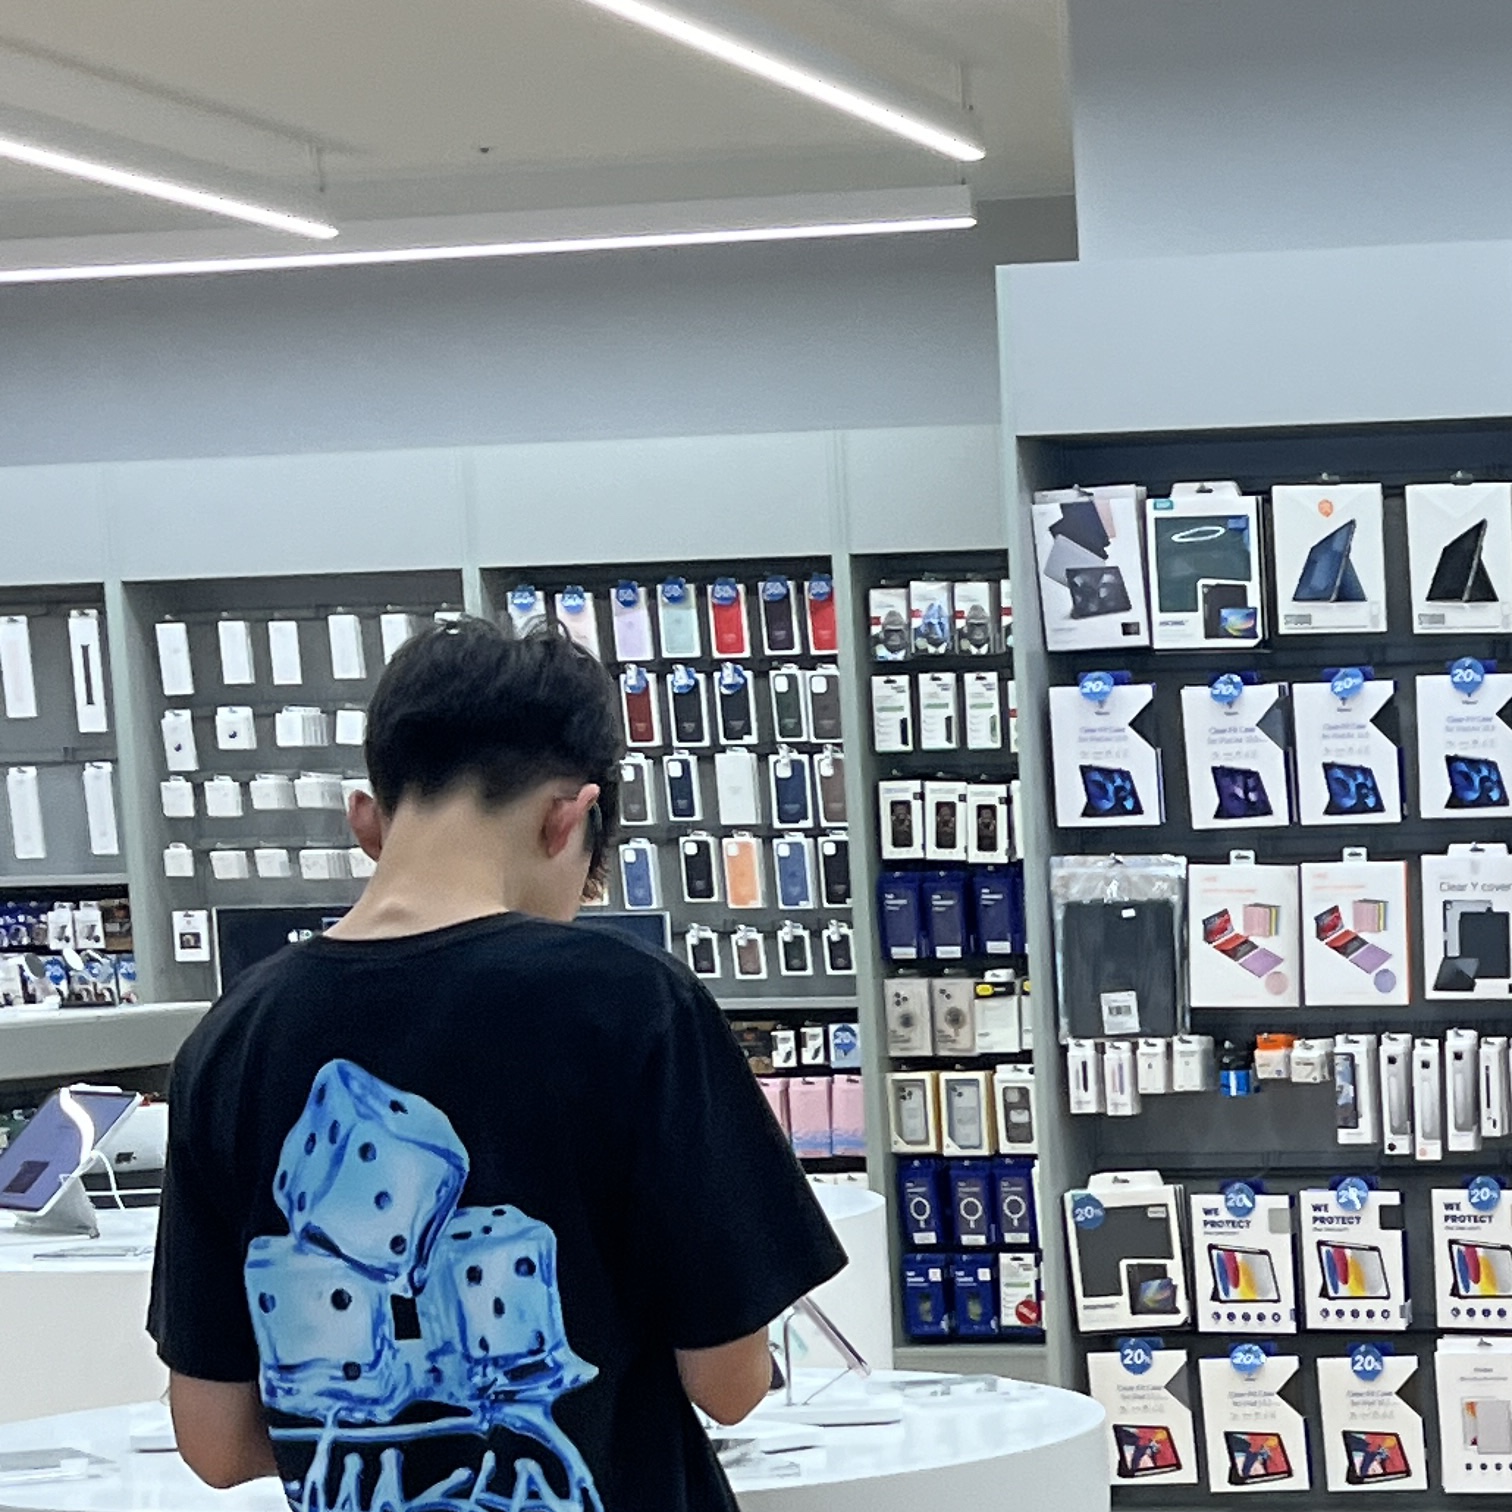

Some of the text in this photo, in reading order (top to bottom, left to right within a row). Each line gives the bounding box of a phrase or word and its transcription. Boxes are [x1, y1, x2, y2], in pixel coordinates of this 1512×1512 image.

[1470, 881, 1479, 891] Y
[1311, 1216, 1362, 1225] PROTECT
[1443, 1214, 1494, 1224] PROTECT
[1203, 1219, 1252, 1230] PROTECT
